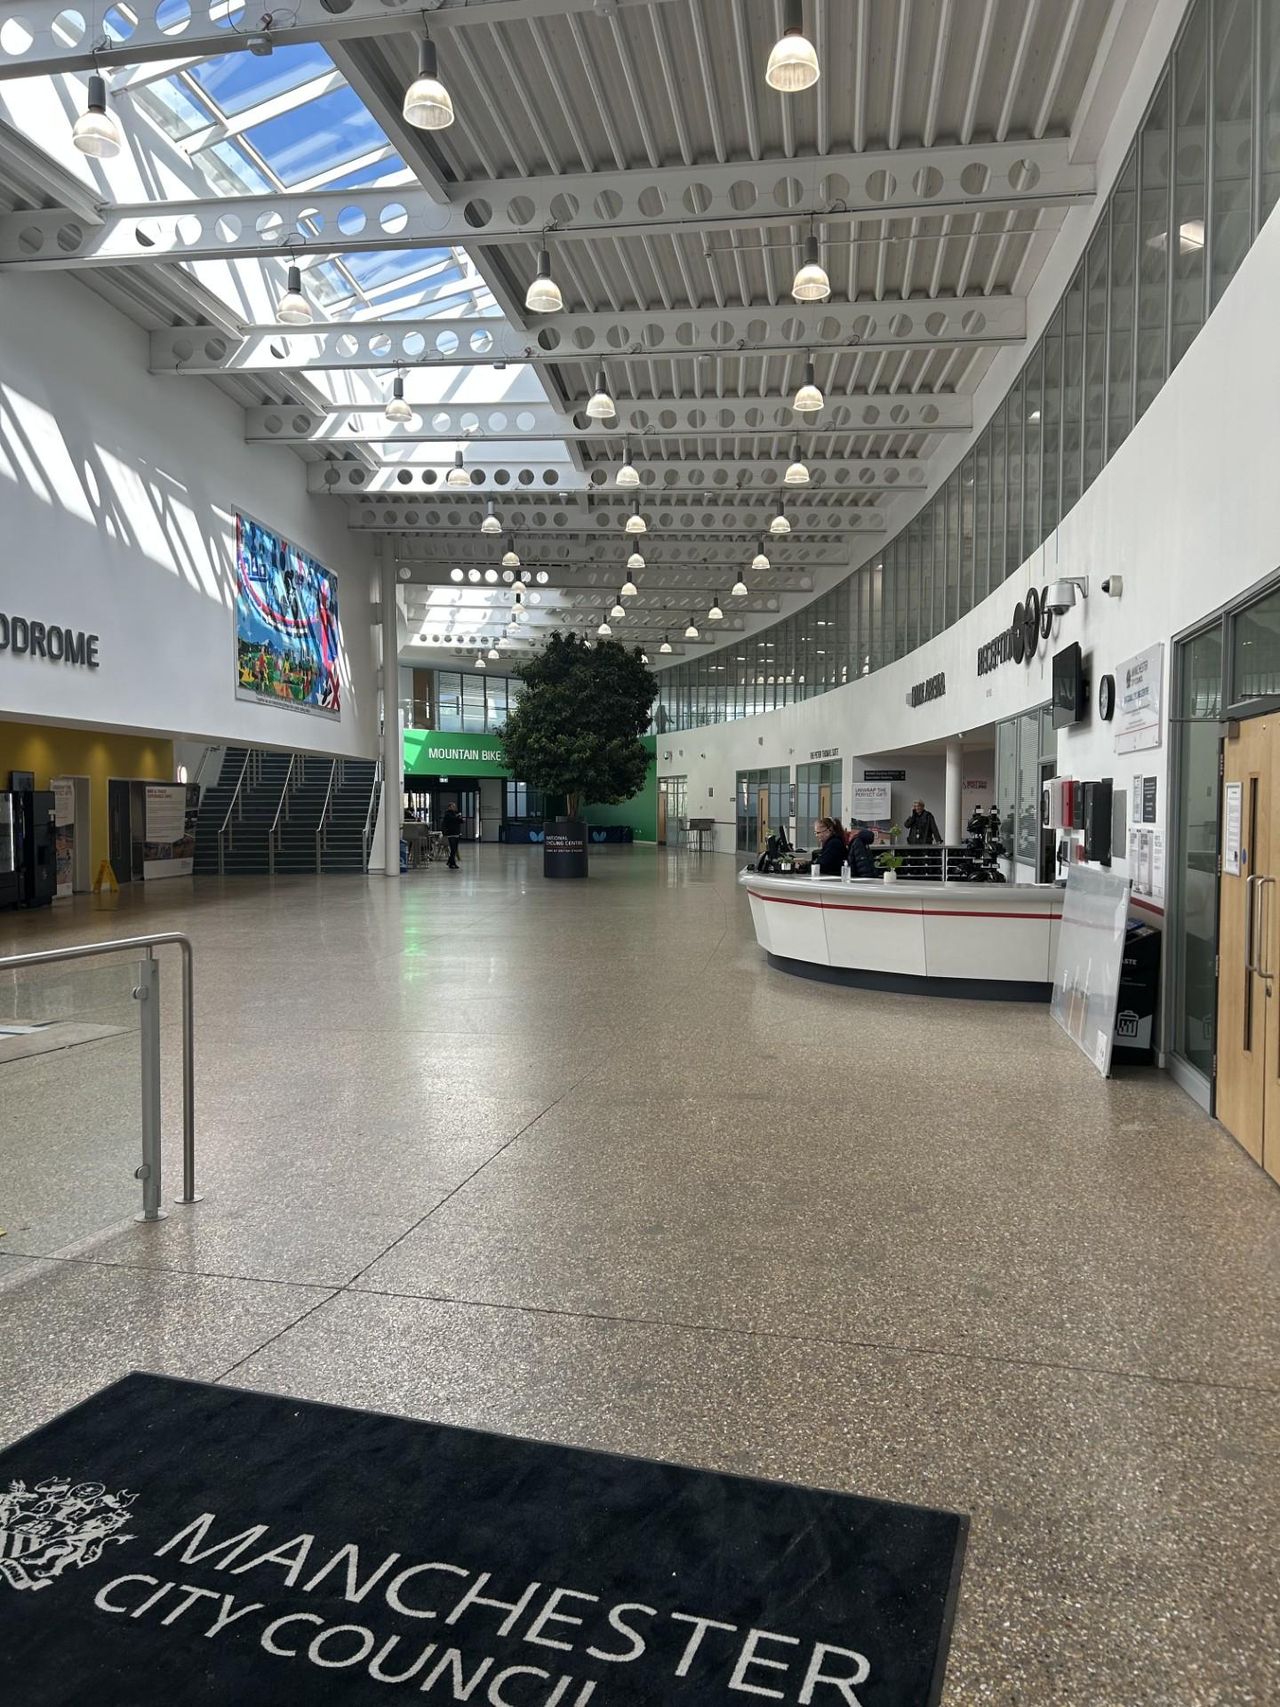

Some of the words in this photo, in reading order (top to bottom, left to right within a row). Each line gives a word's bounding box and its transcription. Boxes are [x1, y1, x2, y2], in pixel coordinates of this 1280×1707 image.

[428, 747, 479, 760] MOUNTAIN
[481, 750, 502, 761] BIKE
[94, 1573, 265, 1639] CITY
[153, 1511, 872, 1707] MANCHESTER
